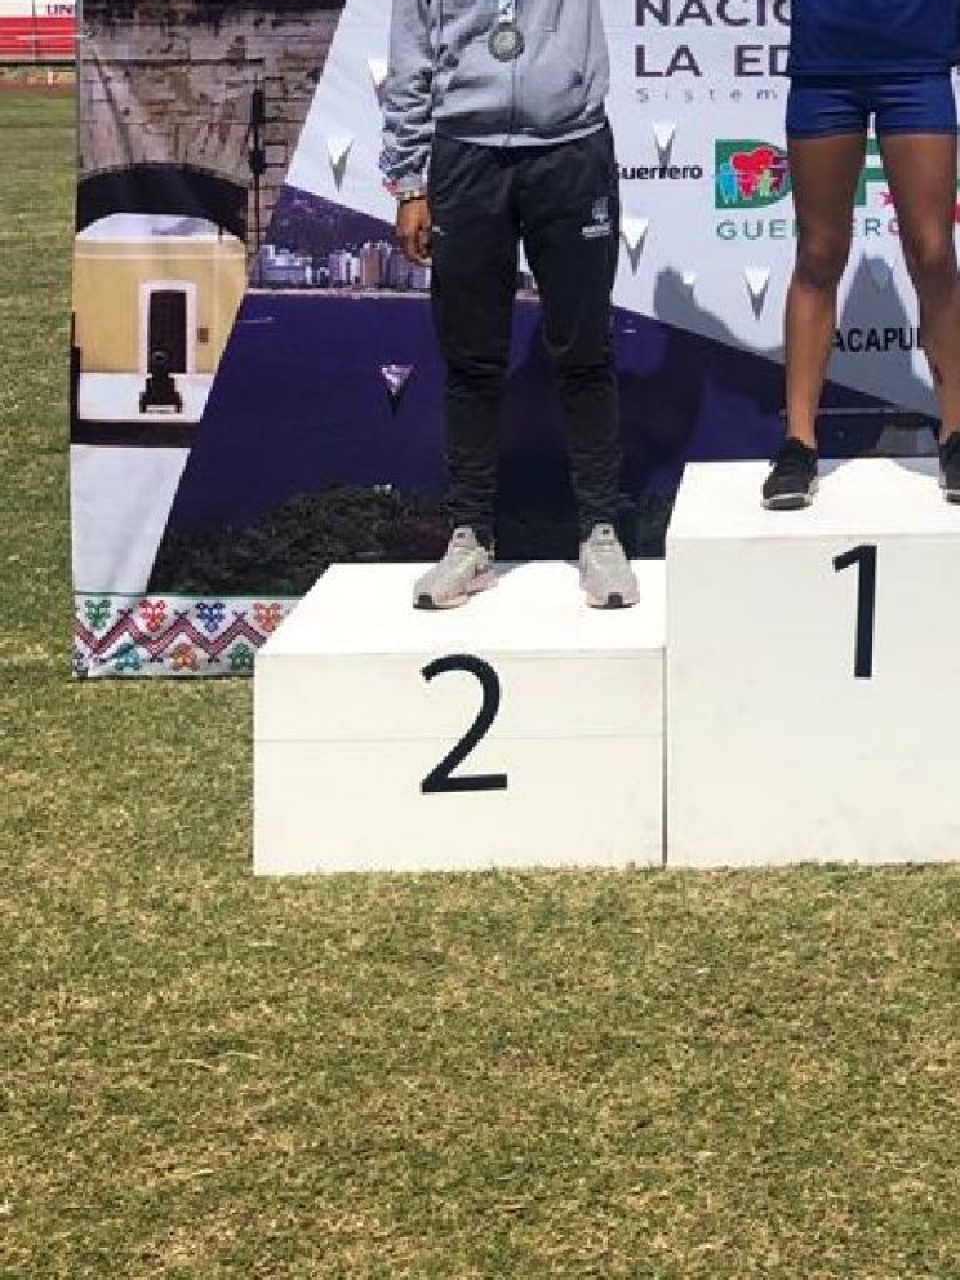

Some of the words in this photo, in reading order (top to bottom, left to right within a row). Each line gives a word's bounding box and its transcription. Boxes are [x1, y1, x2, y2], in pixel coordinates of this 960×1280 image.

[634, 44, 703, 77] LA
[616, 165, 703, 181] uerrero
[832, 544, 877, 680] 1
[420, 653, 508, 794] 2
